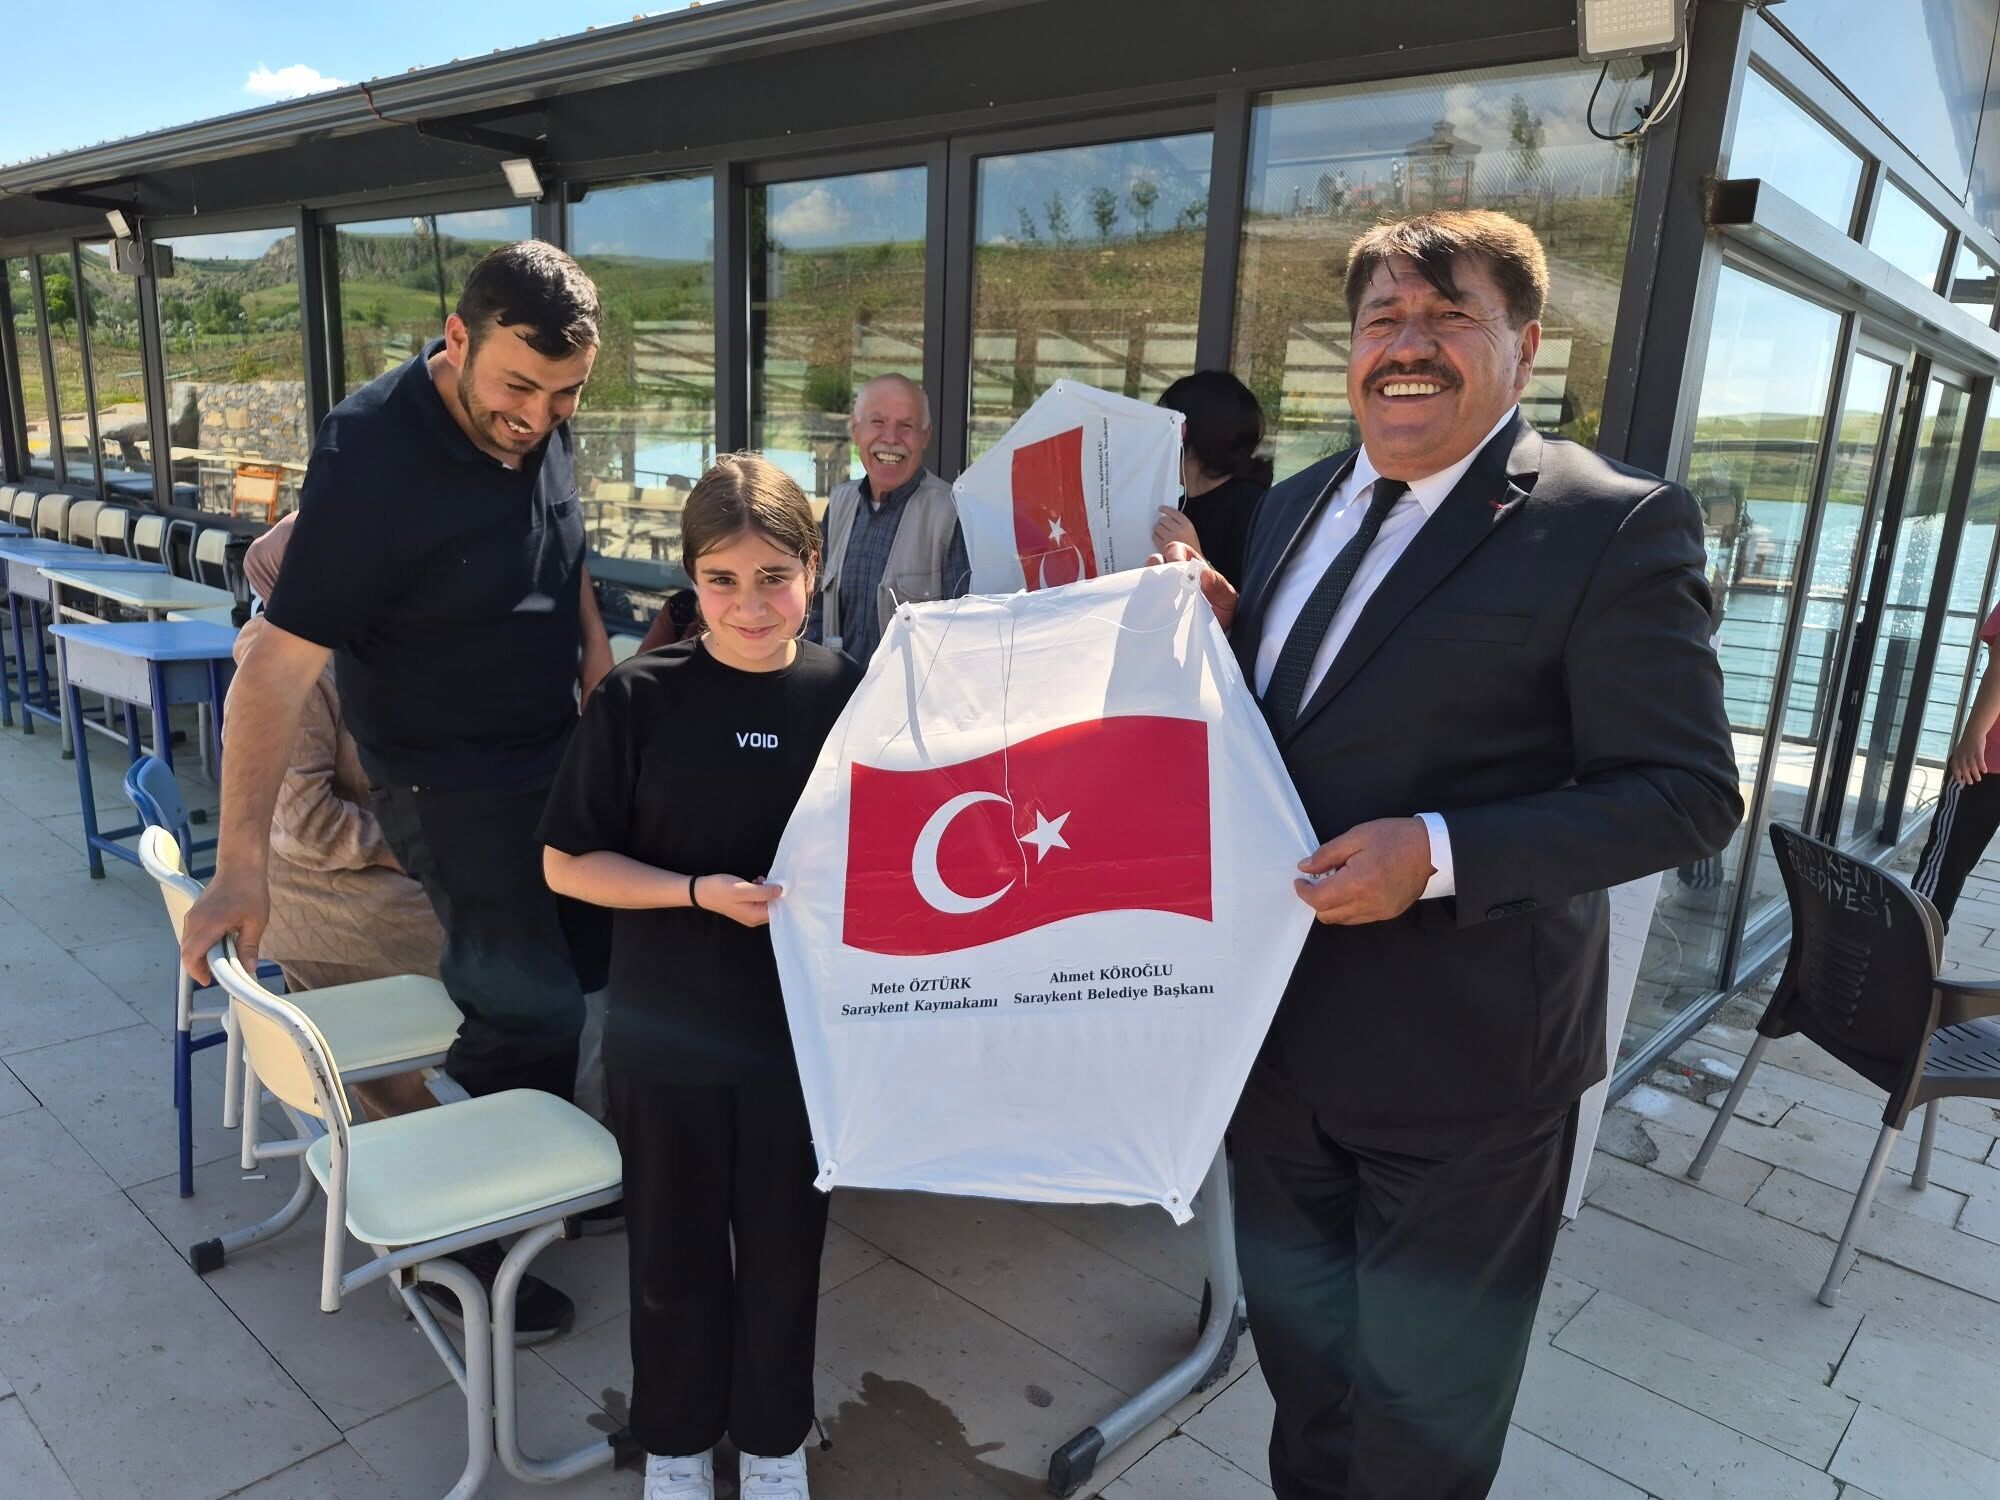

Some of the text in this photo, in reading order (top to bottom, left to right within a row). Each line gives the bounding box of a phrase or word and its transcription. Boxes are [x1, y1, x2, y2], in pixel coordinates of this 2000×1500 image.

[736, 732, 779, 748] VOID
[1049, 963, 1174, 984] Ahmet KÖROĞLU
[870, 976, 972, 995] Mete ÖZTÜRK
[1013, 982, 1215, 1006] Saraykent Belediye Başkanı
[840, 996, 999, 1017] Saraykent Kaymakamı
